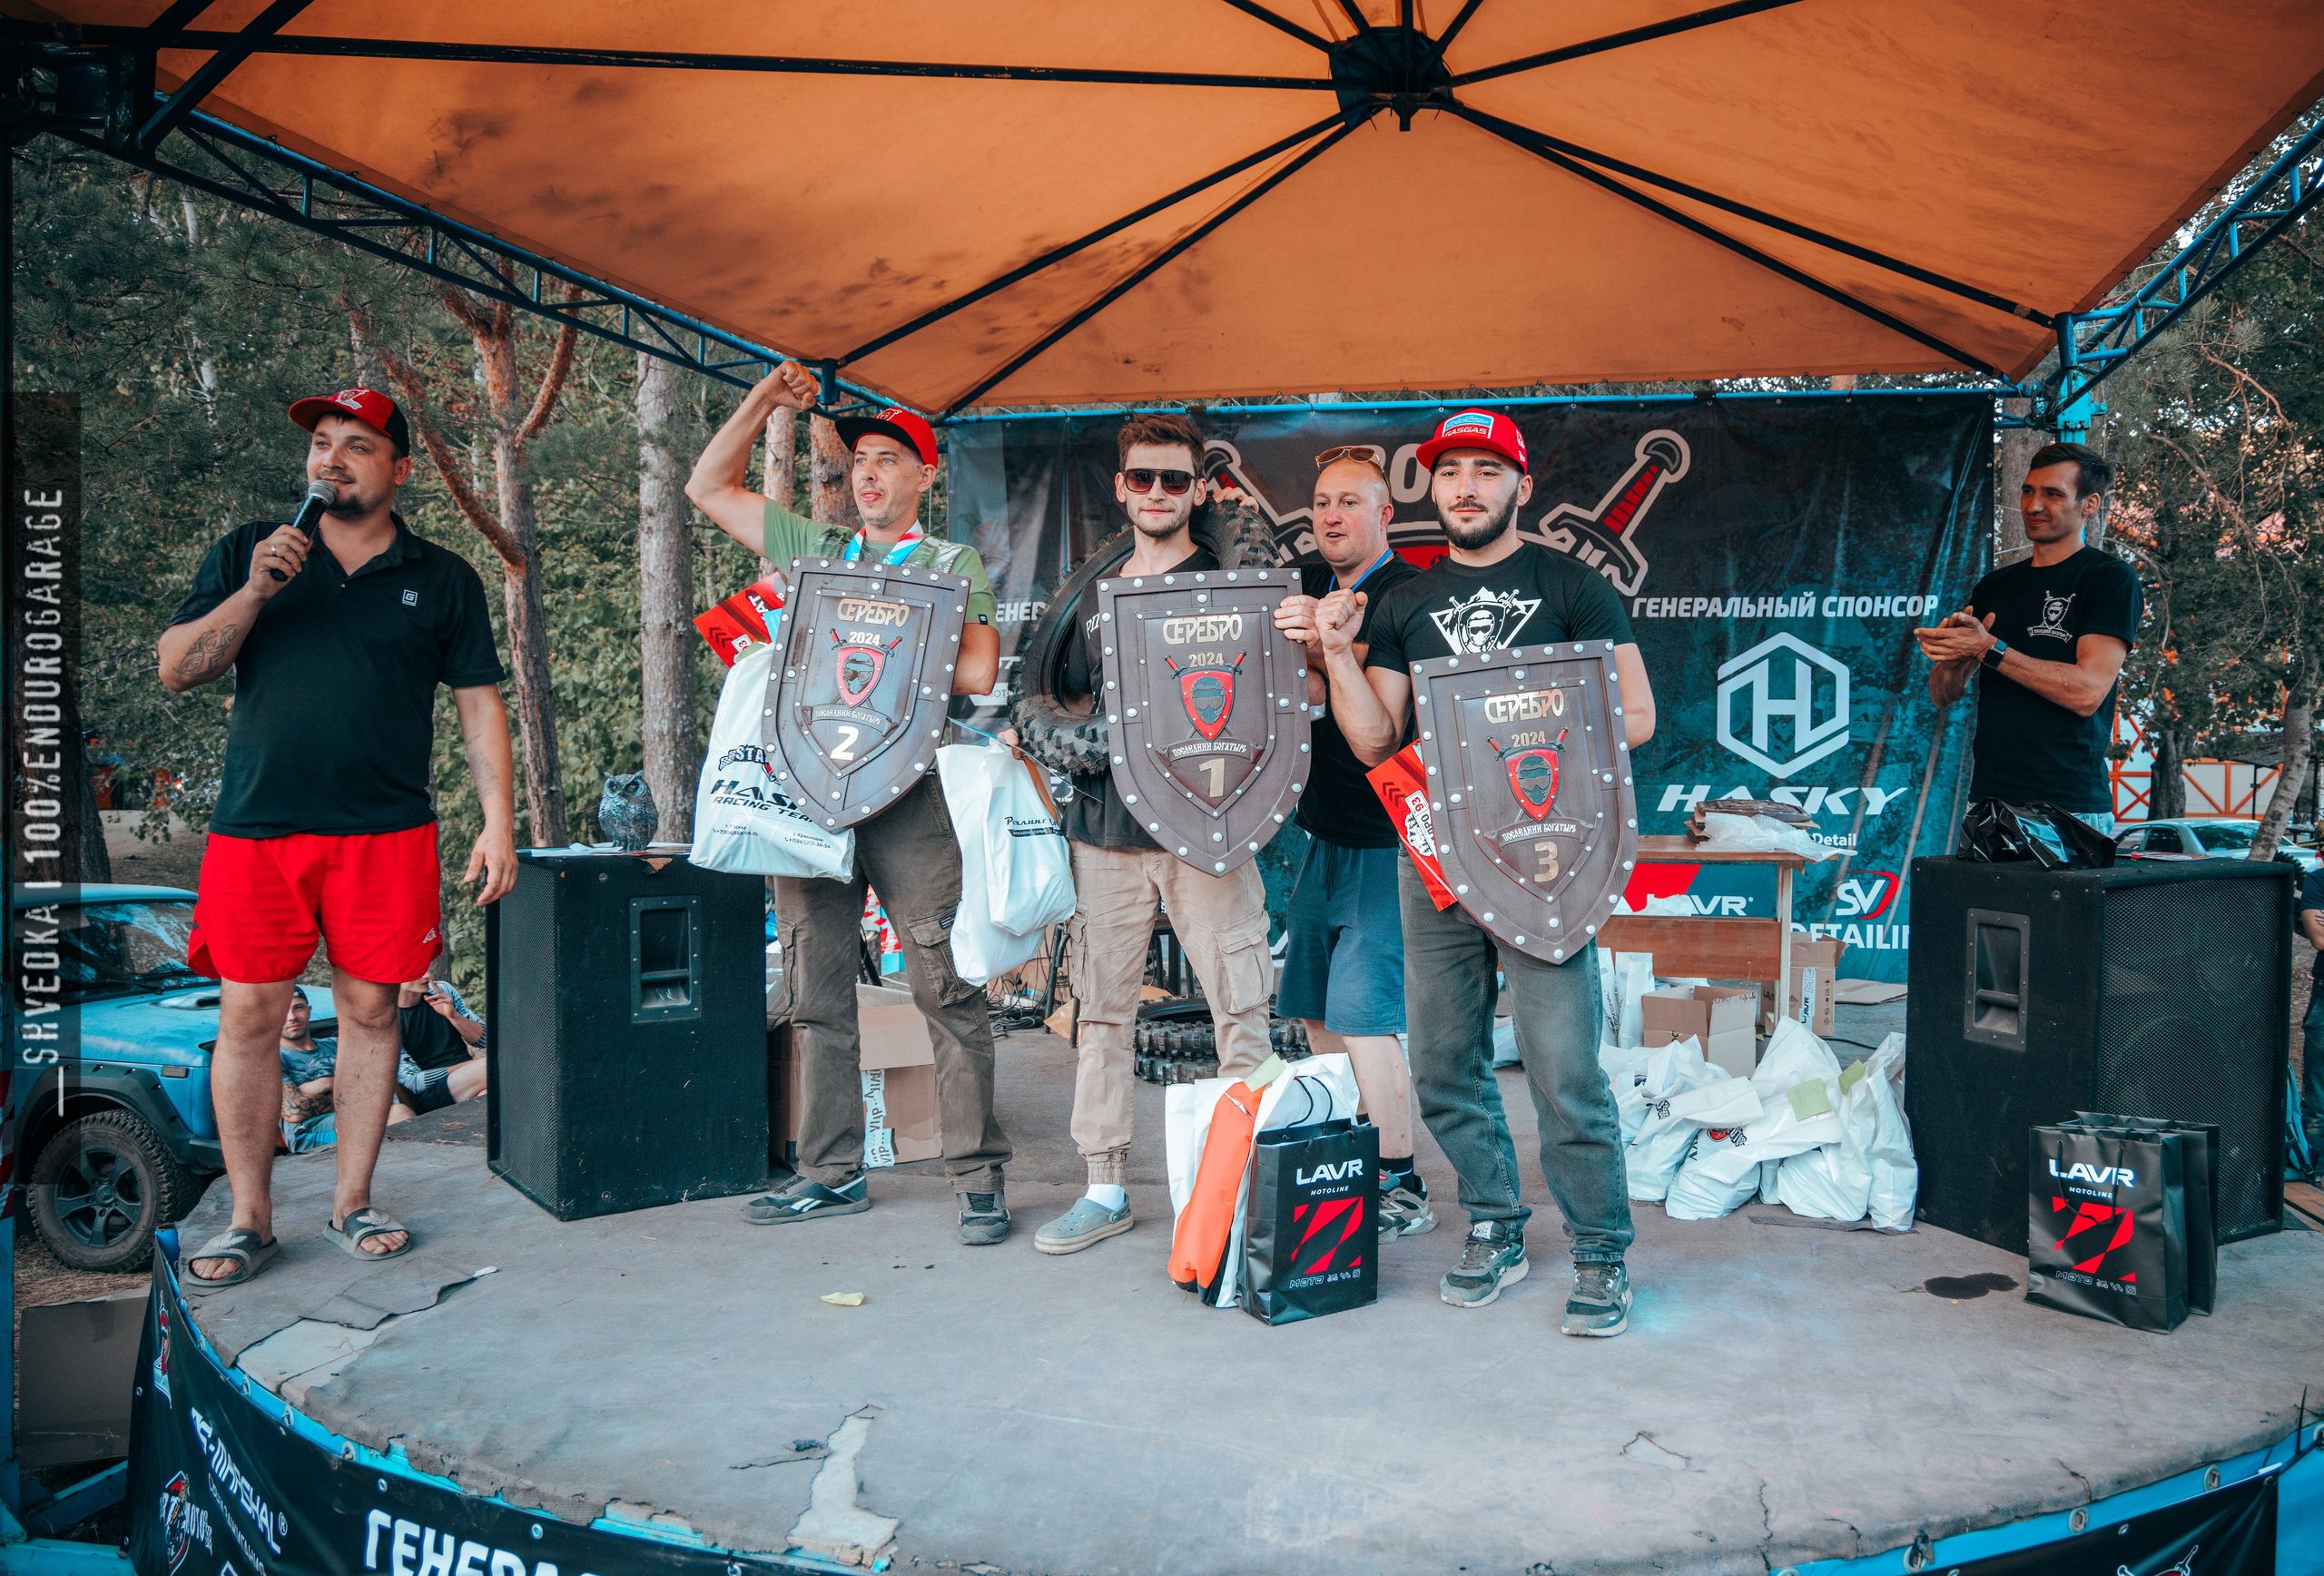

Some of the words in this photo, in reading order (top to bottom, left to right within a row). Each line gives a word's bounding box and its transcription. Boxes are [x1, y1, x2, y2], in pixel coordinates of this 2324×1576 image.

[837, 597, 910, 628] СЕРЕБРО
[1631, 591, 1816, 618] ГЕНЕРАЛЬНЫЙ
[1822, 595, 1939, 618] СПОНСОР
[848, 631, 881, 646] 2024
[1163, 614, 1243, 645] СЕРЕБРО
[1188, 652, 1225, 668] 2024
[1484, 688, 1564, 724] СЕРЕБРО
[830, 725, 860, 761] 2
[1213, 741, 1247, 753] БОГАТЫРЬ
[1511, 731, 1547, 748] 2024
[1198, 758, 1226, 798] 1
[1534, 841, 1560, 883] 3
[1836, 879, 1886, 916] SV
[1296, 1158, 1364, 1187] LAVR
[2048, 1158, 2134, 1188] LAVR
[1310, 1185, 1350, 1197] MOTOLINE
[2068, 1186, 2113, 1199] MOTOLINE
[1289, 1275, 1325, 1289] MOTO
[2055, 1270, 2093, 1285] MOTO
